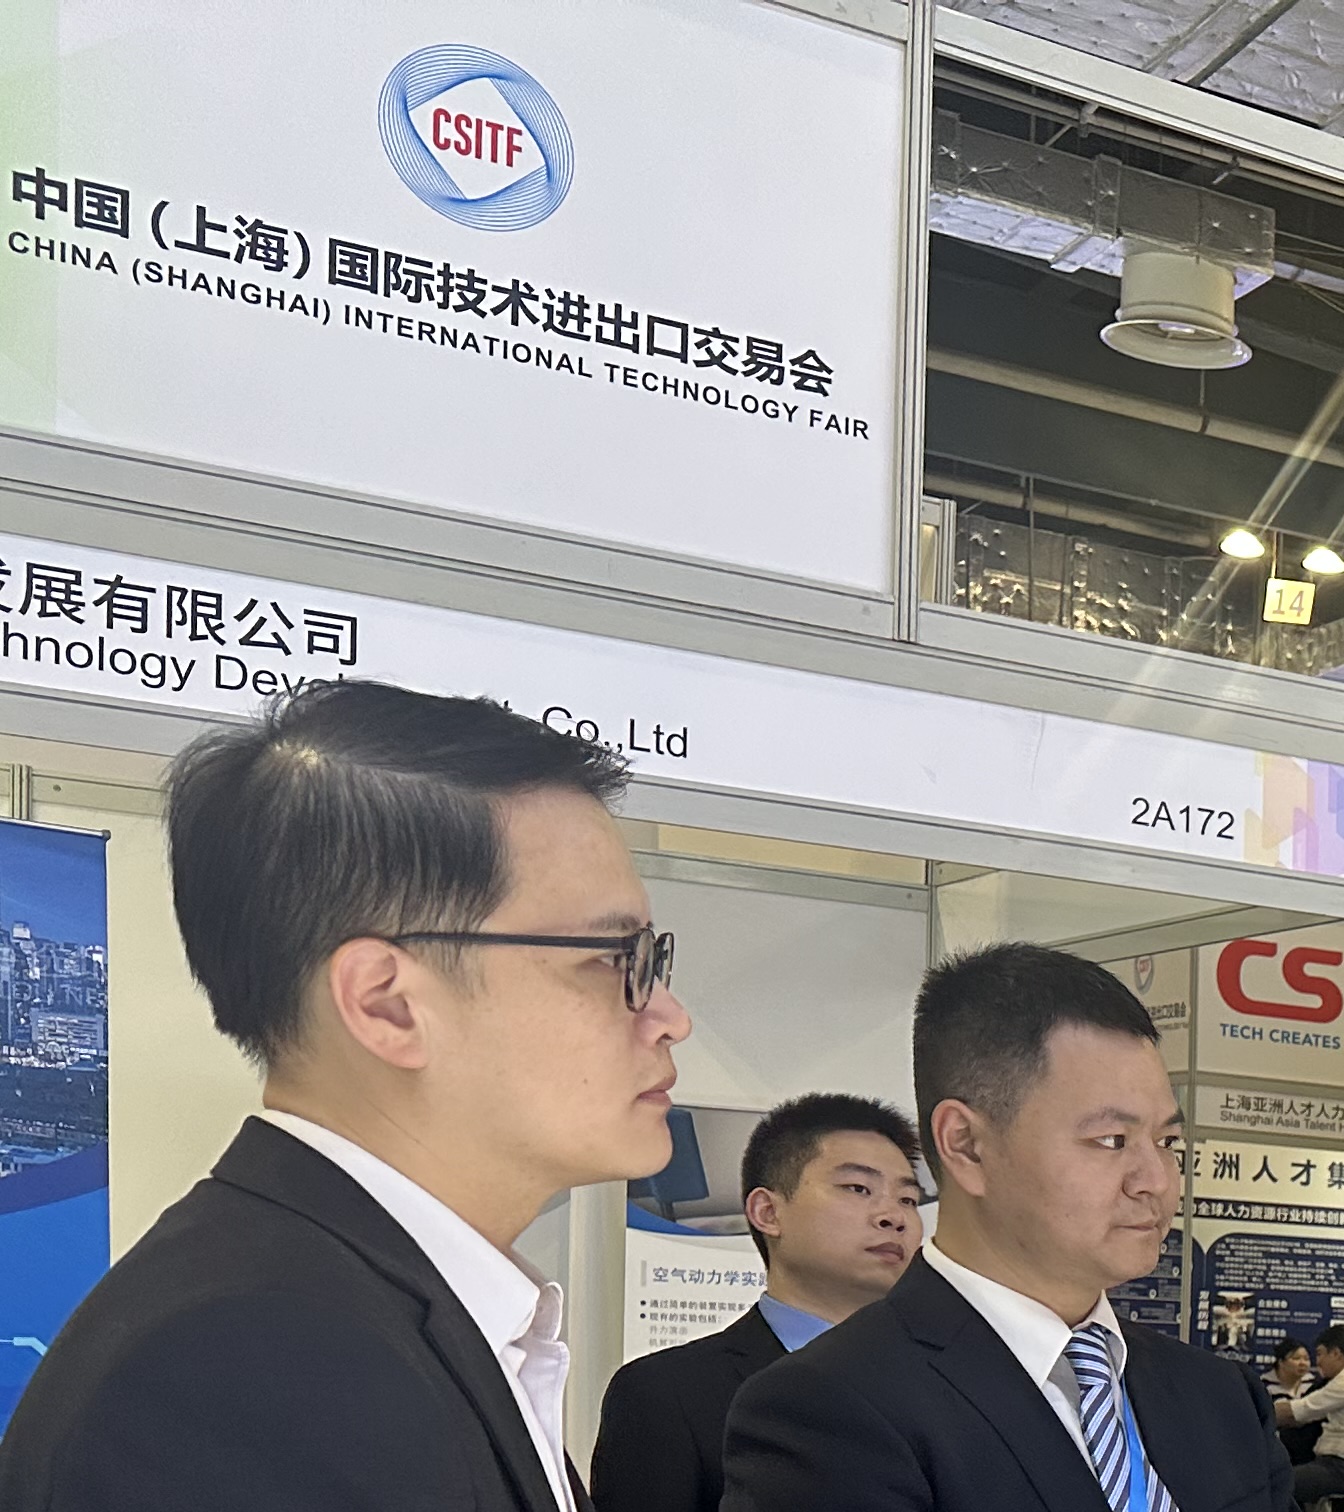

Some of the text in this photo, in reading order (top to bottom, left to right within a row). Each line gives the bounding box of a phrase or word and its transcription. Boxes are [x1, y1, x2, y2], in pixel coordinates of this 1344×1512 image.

[431, 106, 524, 170] CSITF
[11, 167, 834, 397] 中国（上海）国际技术进出口交易会
[7, 230, 871, 440] CHINA (SHANGHAI) INTERNATIONAL TECHNOLOGY FAIR
[0, 560, 358, 666] 展有限公司
[1271, 588, 1306, 618] 14
[1131, 797, 1236, 841] 2A172
[1219, 1023, 1264, 1041] TECH
[1269, 1030, 1341, 1051] CREATES
[1220, 1111, 1275, 1128] Shanghai
[1276, 1116, 1301, 1128] Asia
[1304, 1119, 1336, 1133] Talent
[650, 1299, 753, 1312] 通过简单的装置实现多
